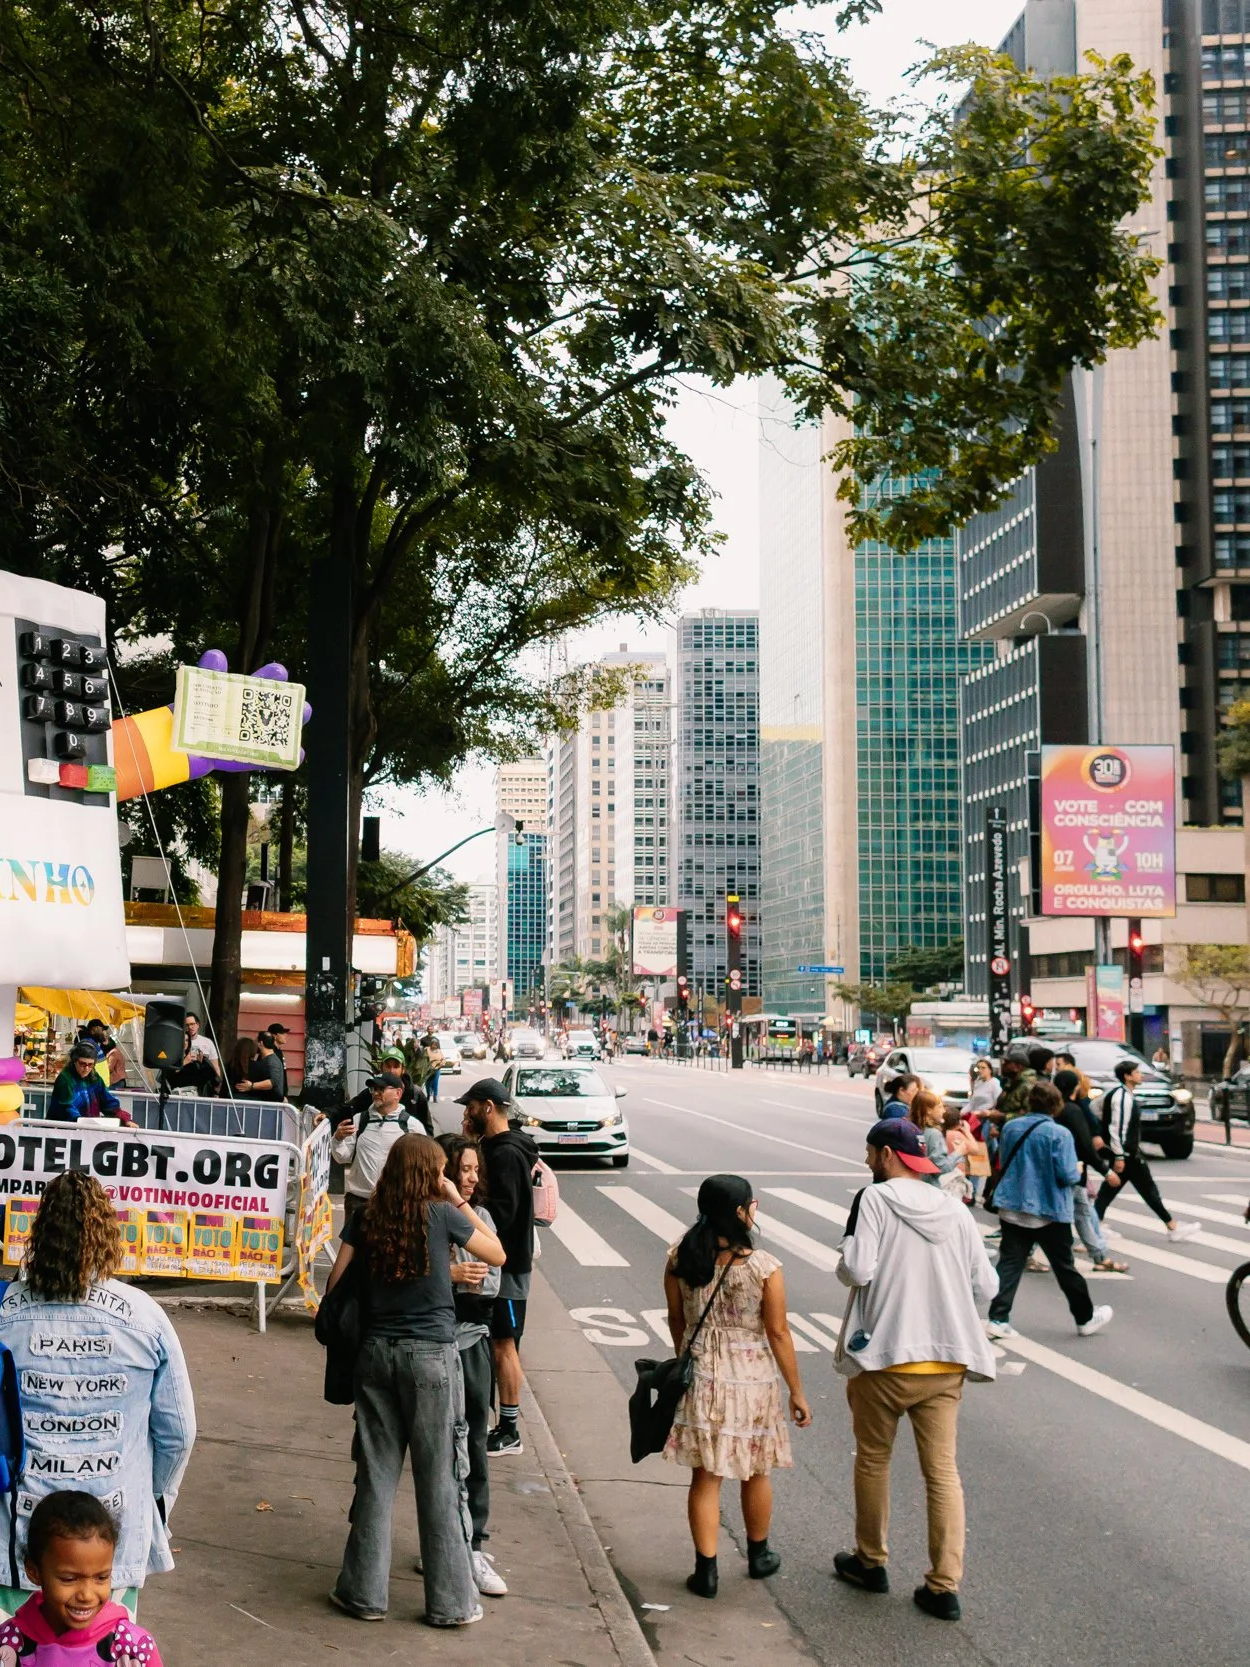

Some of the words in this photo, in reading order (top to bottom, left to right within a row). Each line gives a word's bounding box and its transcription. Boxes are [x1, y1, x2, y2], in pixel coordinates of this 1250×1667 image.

[35, 637, 42, 650] 1
[62, 643, 71, 658] 2
[85, 651, 94, 664] 3
[36, 667, 45, 680] 4
[64, 674, 73, 687] 5
[85, 681, 94, 694] 6
[38, 697, 45, 710] 7
[66, 703, 75, 716] 8
[87, 708, 97, 722] 9
[69, 733, 78, 747] 0
[1054, 800, 1098, 812] VOTE
[1125, 800, 1163, 813] COM
[1054, 812, 1164, 827] CONSCIÊNCIA
[992, 832, 1004, 880] Azevedo
[1054, 850, 1074, 865] 07
[1135, 852, 1163, 868] 10H
[993, 881, 1005, 915] Rocha
[1129, 885, 1164, 897] LUTA
[1054, 897, 1063, 909] E
[1066, 897, 1163, 910] CONQUISTAS
[104, 1184, 270, 1213] @VOTINHOOFICIAL
[146, 1225, 183, 1244] VOTO
[194, 1228, 231, 1248] VOTO
[242, 1231, 279, 1252] VOTO
[40, 1338, 107, 1353] PARIS
[26, 1375, 65, 1390] NEW
[76, 1378, 121, 1393] YORK
[27, 1415, 118, 1432] LONDON
[30, 1457, 114, 1474] MILAN
